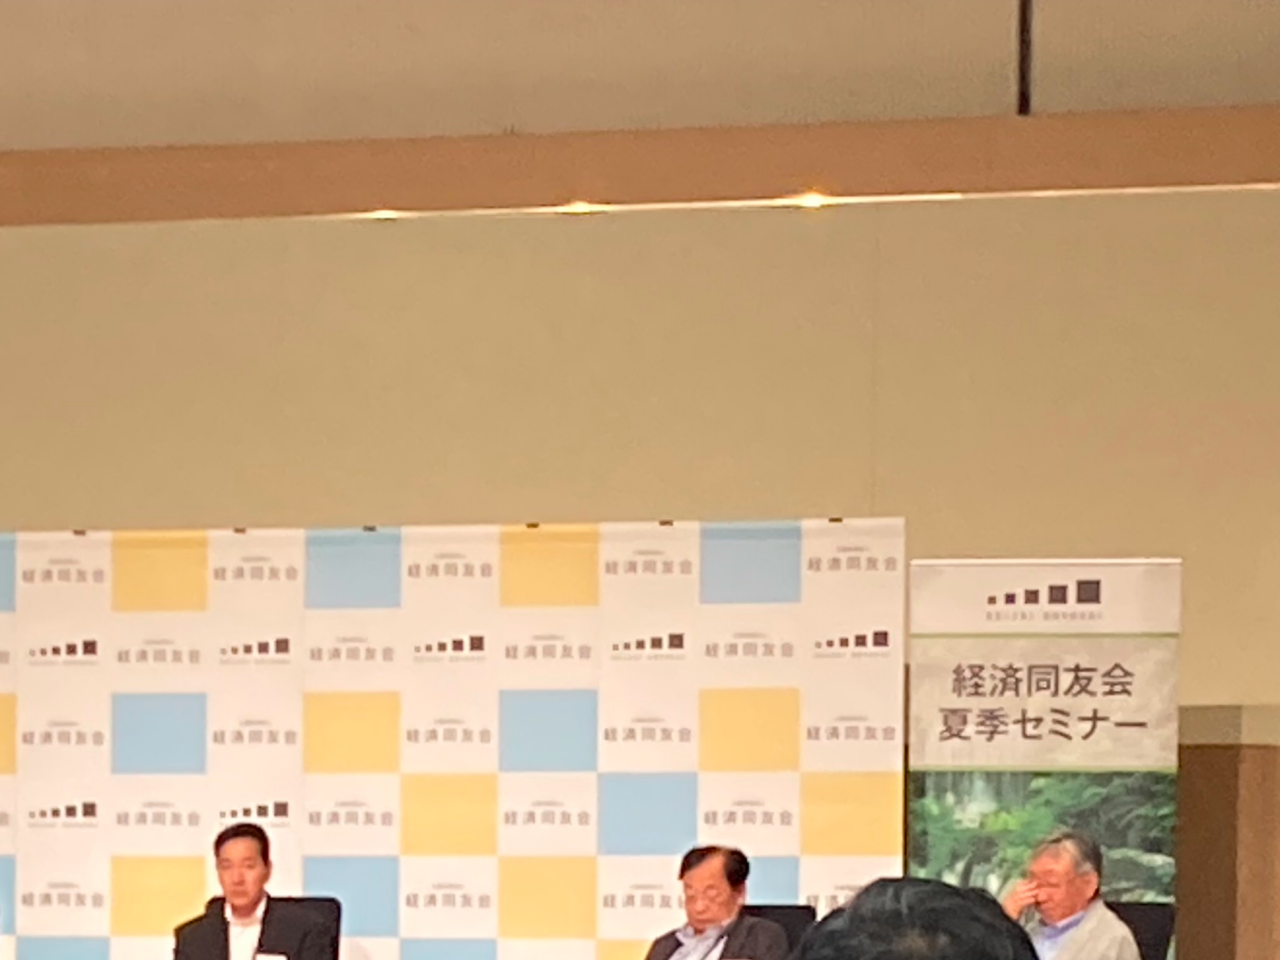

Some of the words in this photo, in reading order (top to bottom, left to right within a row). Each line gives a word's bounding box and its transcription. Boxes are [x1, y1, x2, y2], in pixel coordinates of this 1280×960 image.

[951, 662, 1135, 698] 経済同友会
[938, 706, 1149, 743] 夏季セミナー
